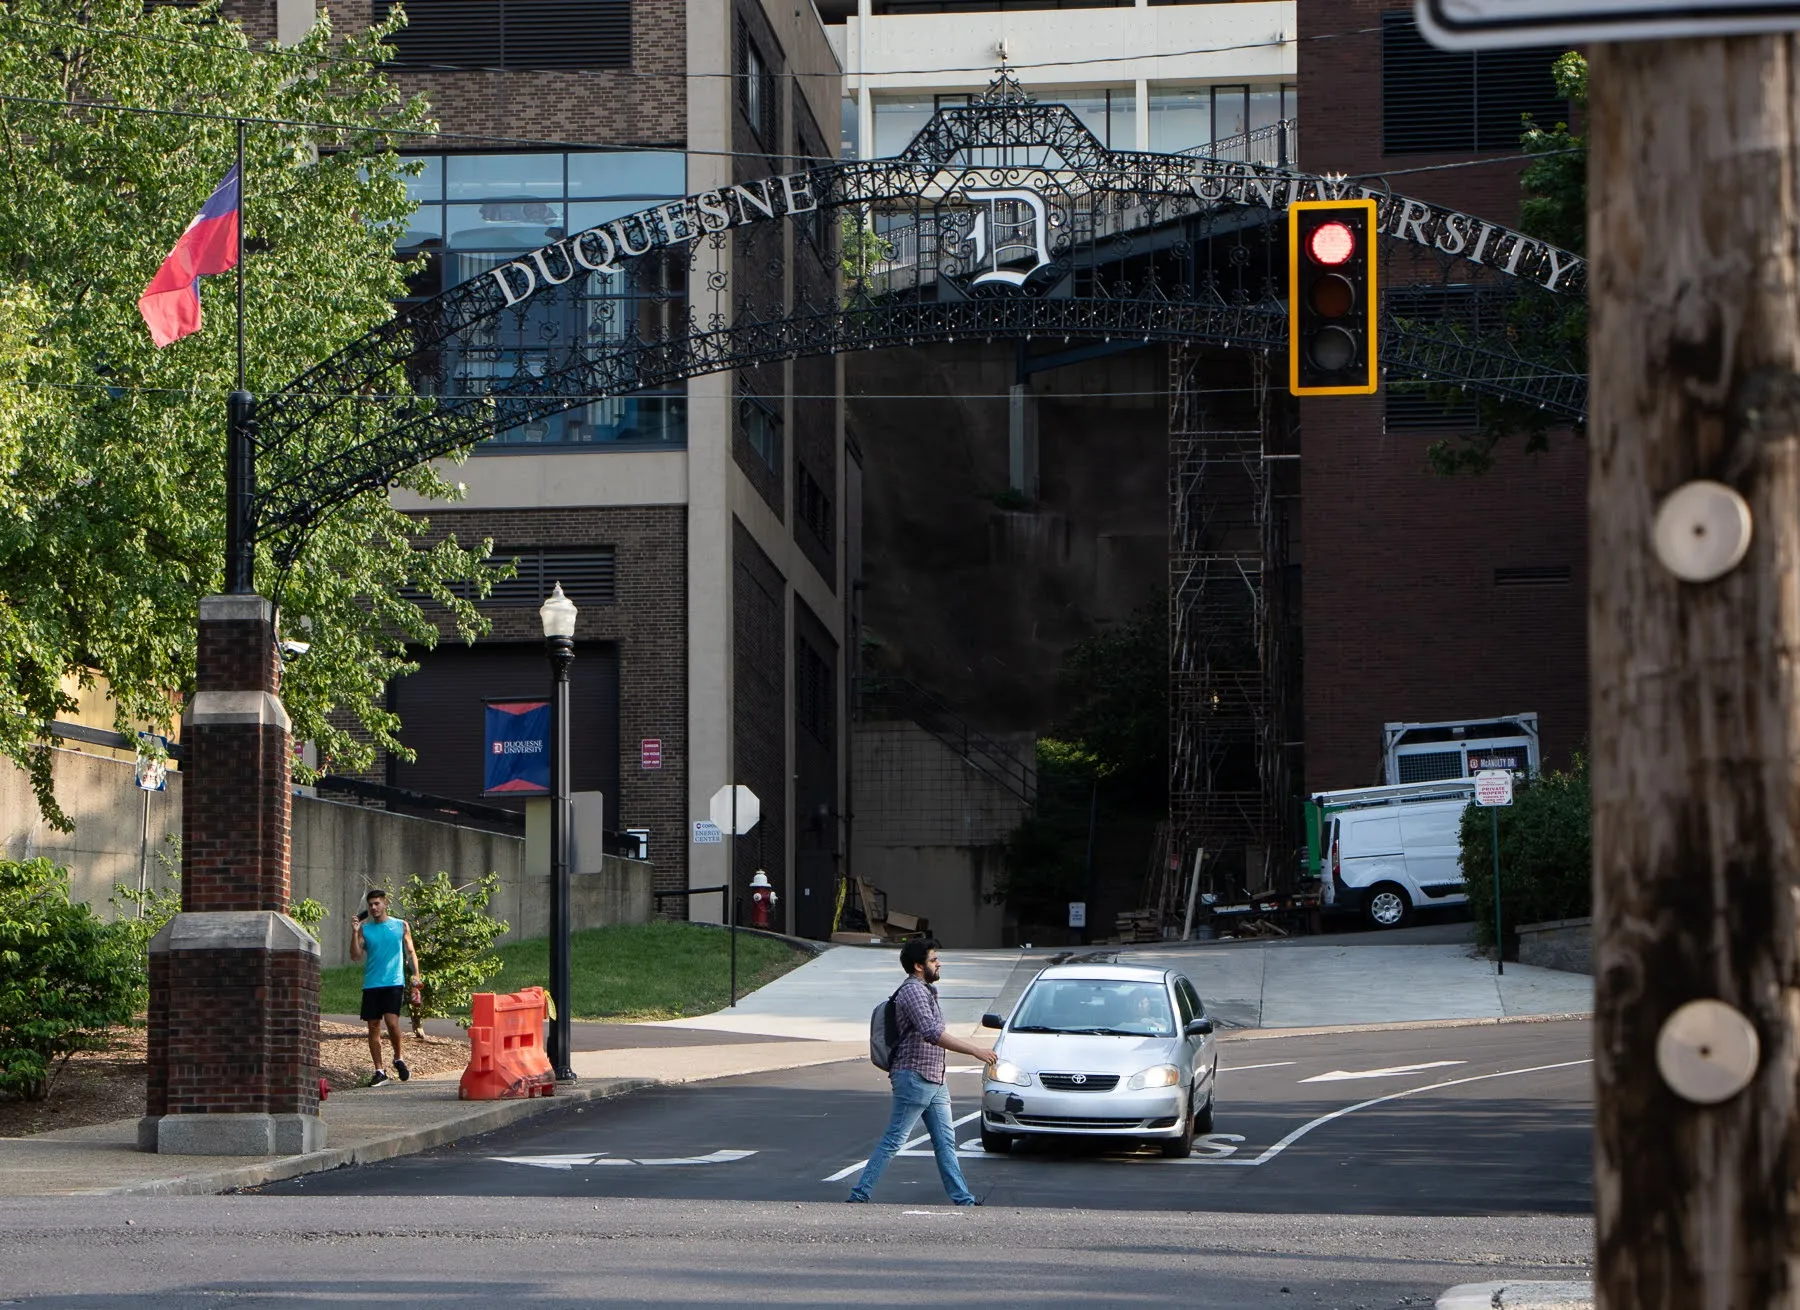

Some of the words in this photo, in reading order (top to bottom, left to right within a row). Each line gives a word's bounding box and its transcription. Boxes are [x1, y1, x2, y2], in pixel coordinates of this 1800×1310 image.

[489, 172, 817, 308] DUQUESNE
[504, 740, 543, 748] DUQUESNE
[504, 746, 543, 754] UNIVERSITY
